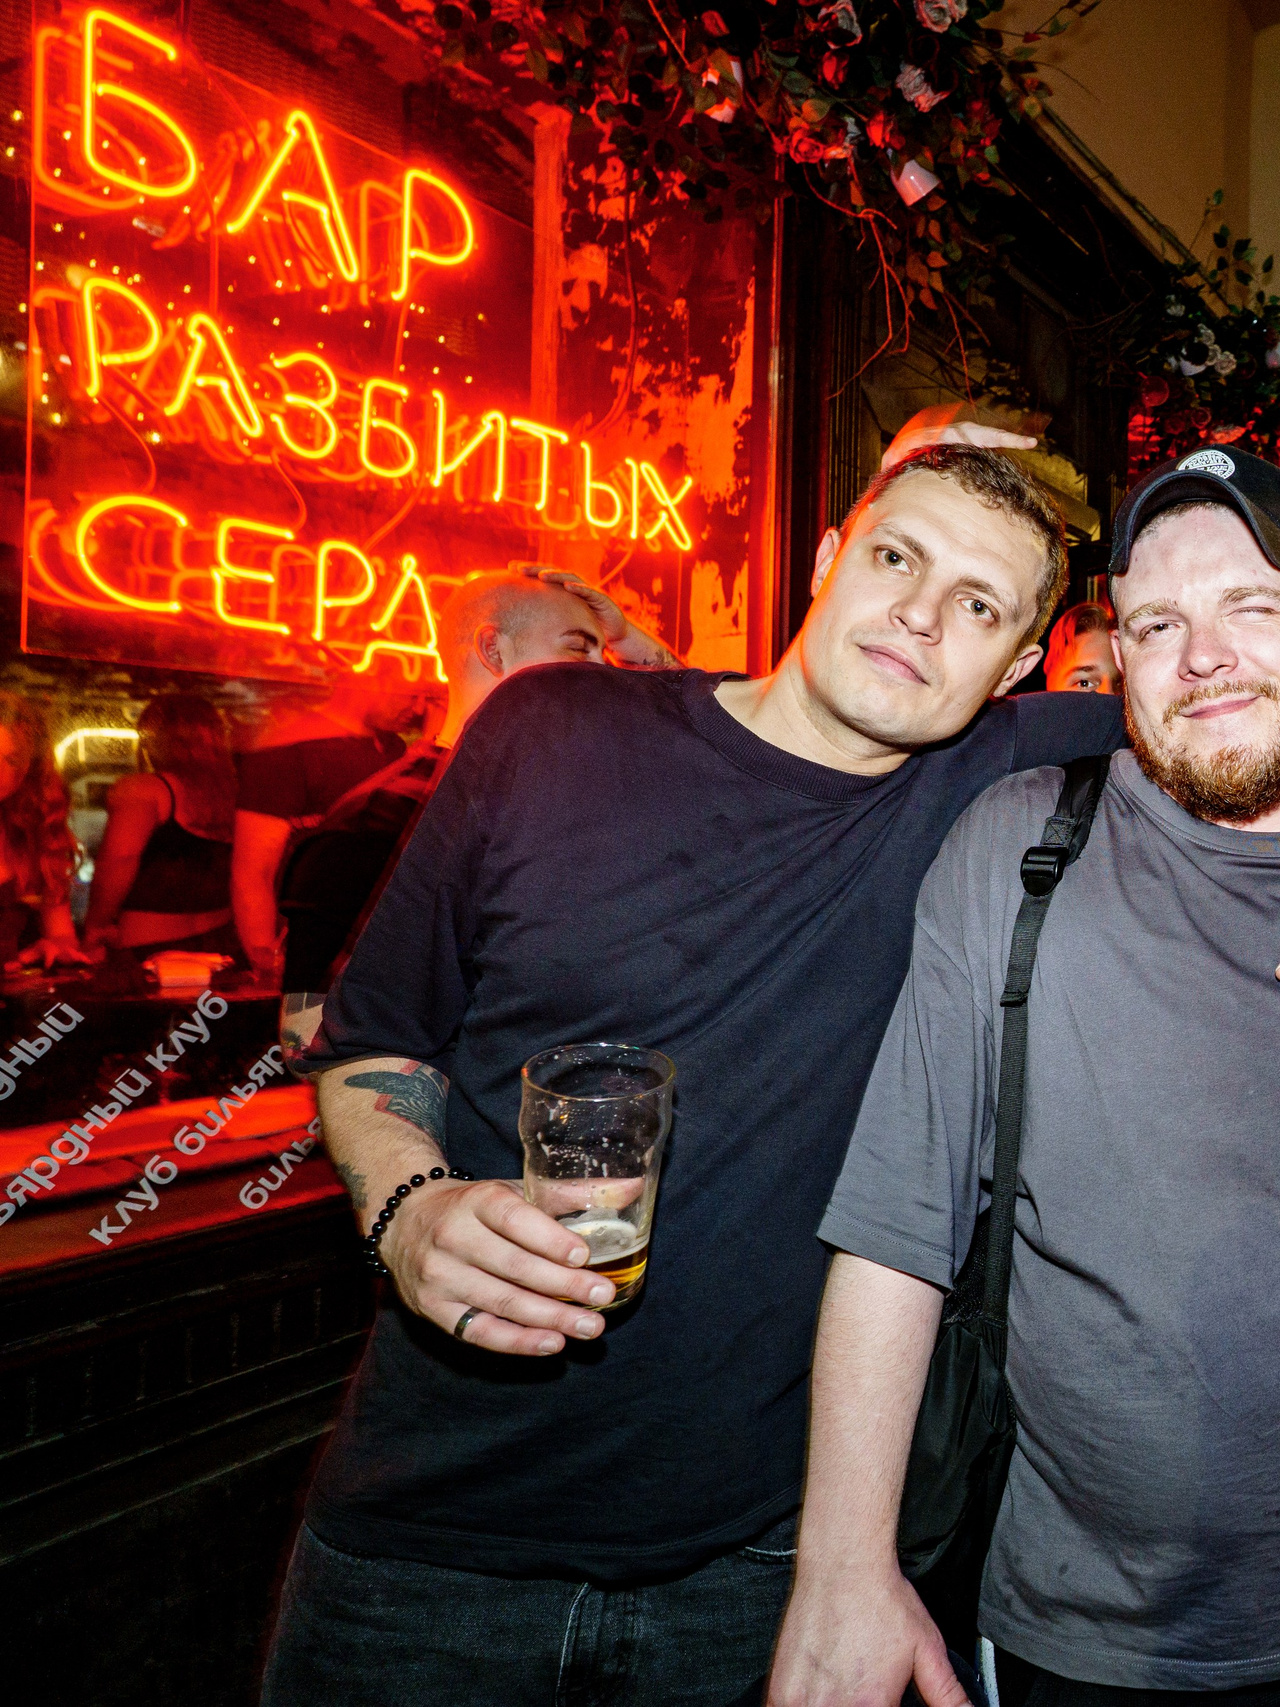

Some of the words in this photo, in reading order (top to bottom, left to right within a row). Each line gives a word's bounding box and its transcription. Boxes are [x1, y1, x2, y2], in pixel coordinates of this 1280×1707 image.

[84, 10, 475, 301] БАР
[83, 277, 693, 551] РАЗБИТЫХ
[77, 495, 450, 683] СЕРД
[145, 989, 228, 1073] клуб
[88, 1155, 179, 1246] клуб
